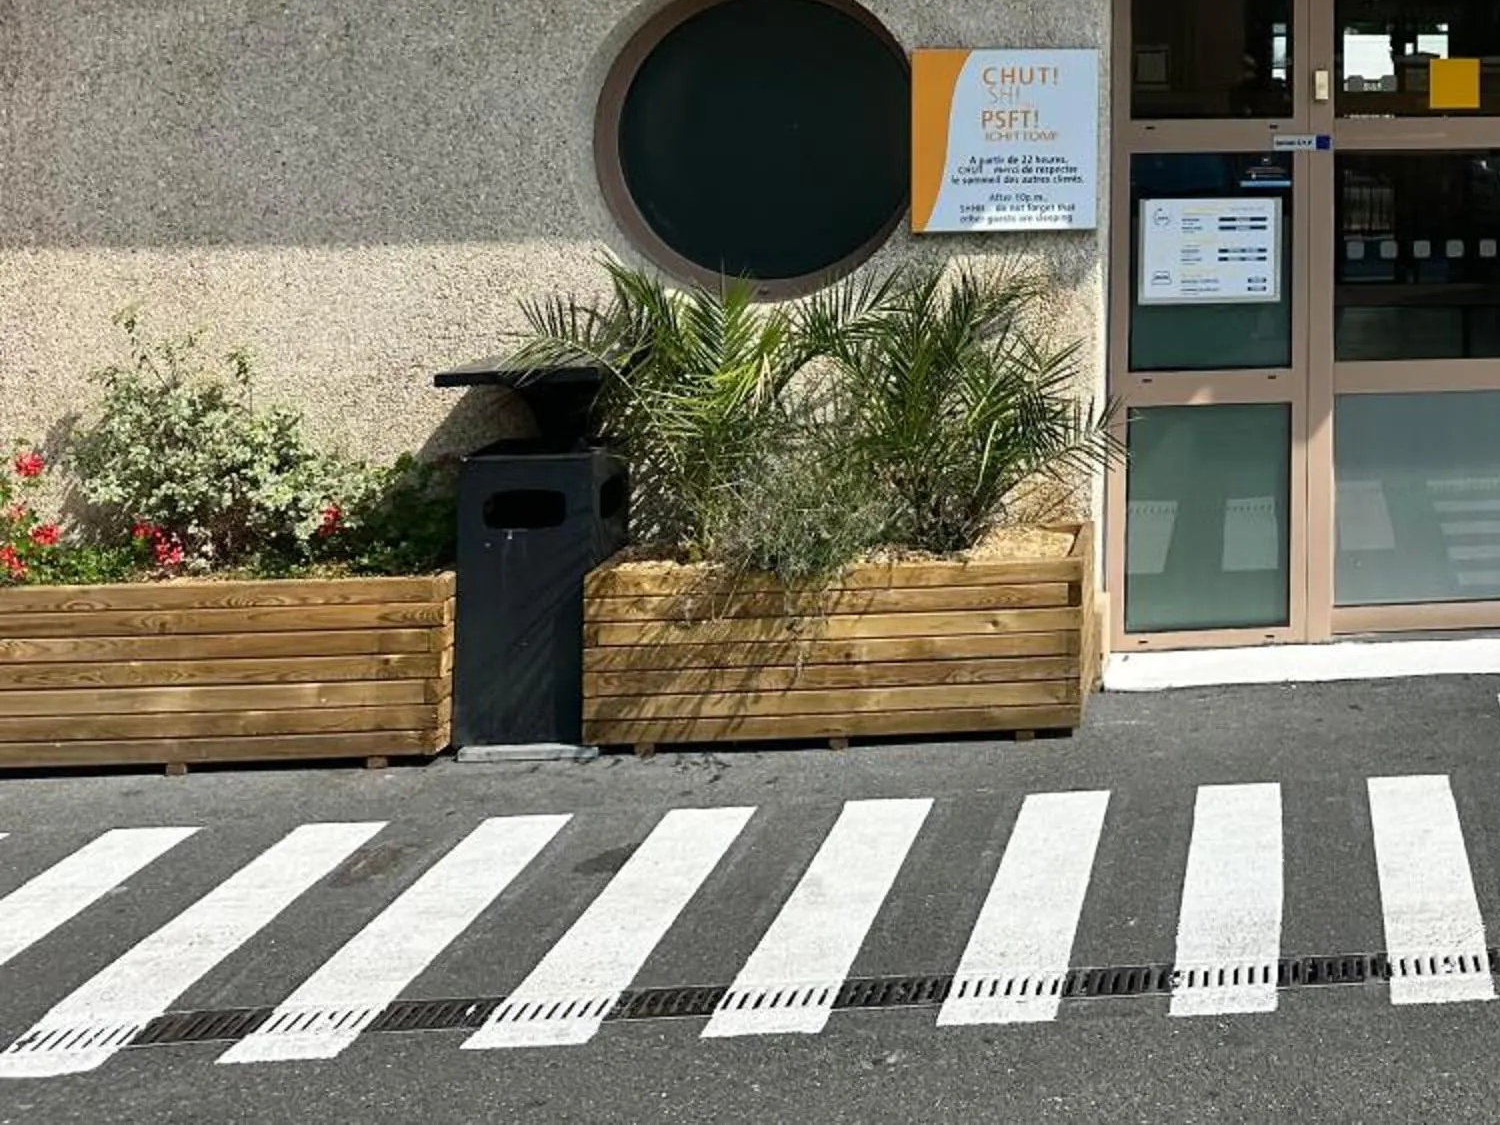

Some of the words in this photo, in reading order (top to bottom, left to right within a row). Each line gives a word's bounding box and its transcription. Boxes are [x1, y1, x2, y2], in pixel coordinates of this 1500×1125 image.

[982, 66, 1058, 86] CHUT!
[1007, 155, 1019, 164] de
[1021, 155, 1033, 164] 22
[1021, 165, 1033, 174] de
